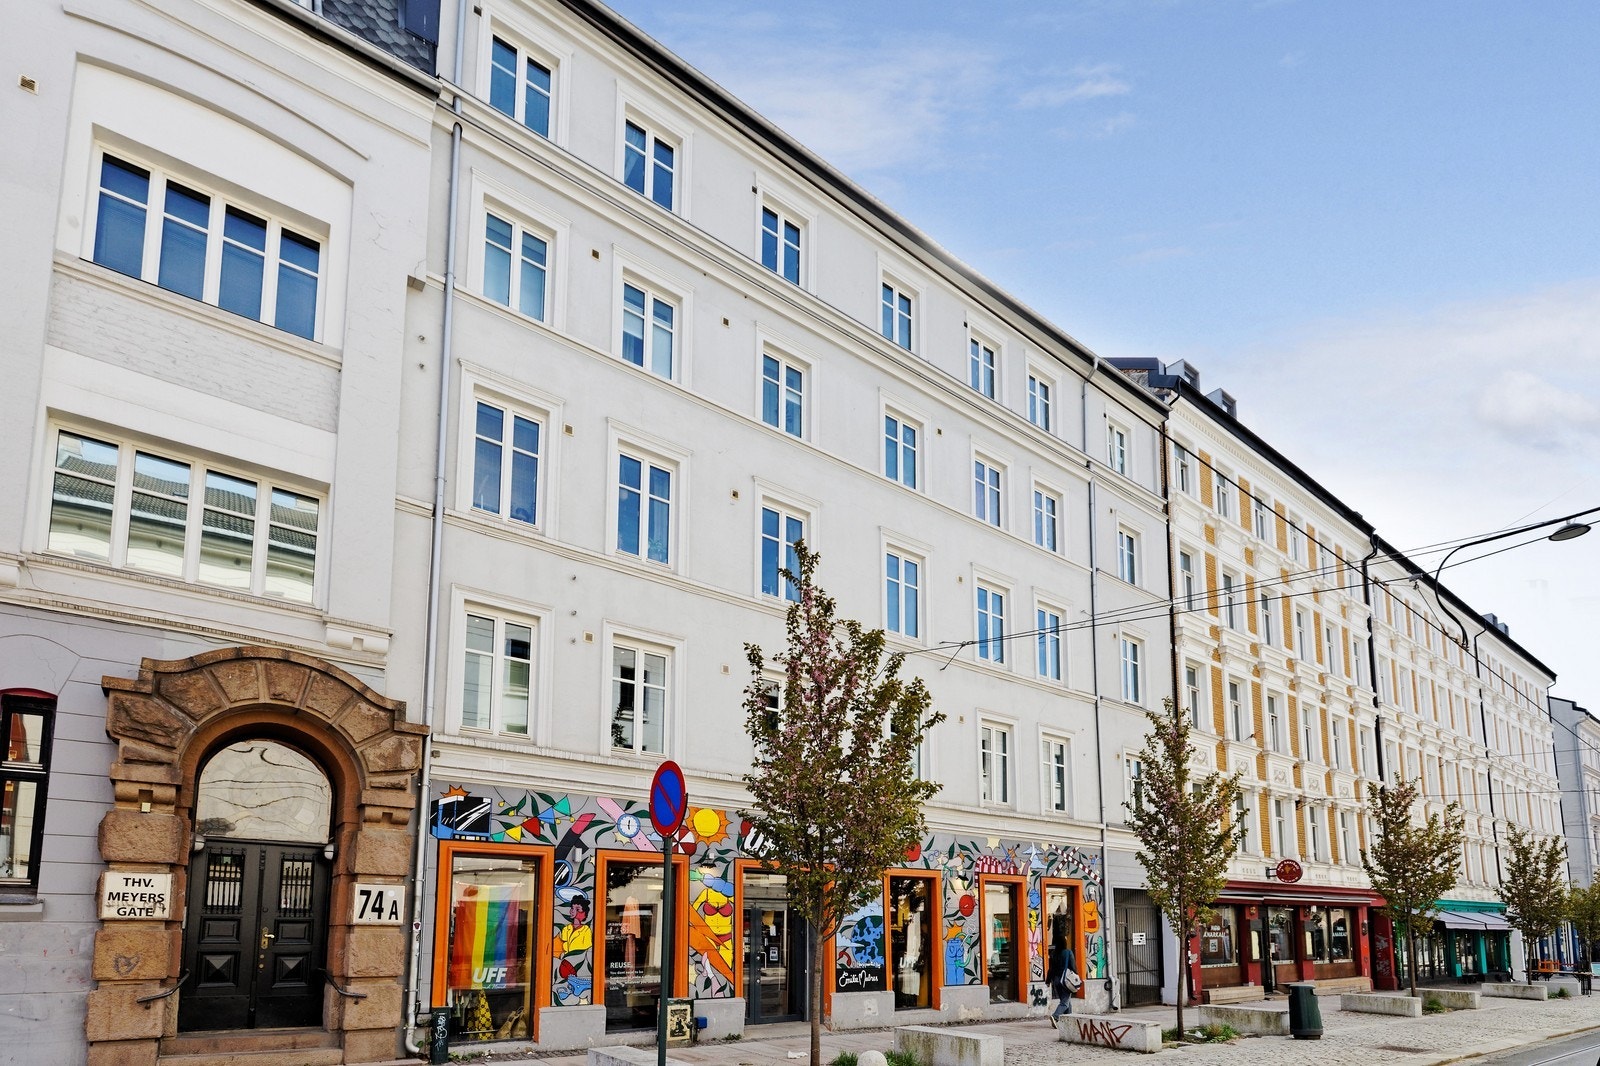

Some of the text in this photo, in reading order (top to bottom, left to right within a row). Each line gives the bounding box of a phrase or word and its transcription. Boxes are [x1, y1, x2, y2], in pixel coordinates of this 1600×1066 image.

[123, 877, 154, 888] THV.
[108, 892, 165, 903] MEYERS
[359, 890, 399, 921] 74 A
[117, 907, 153, 917] GATE
[473, 967, 508, 983] UFF
